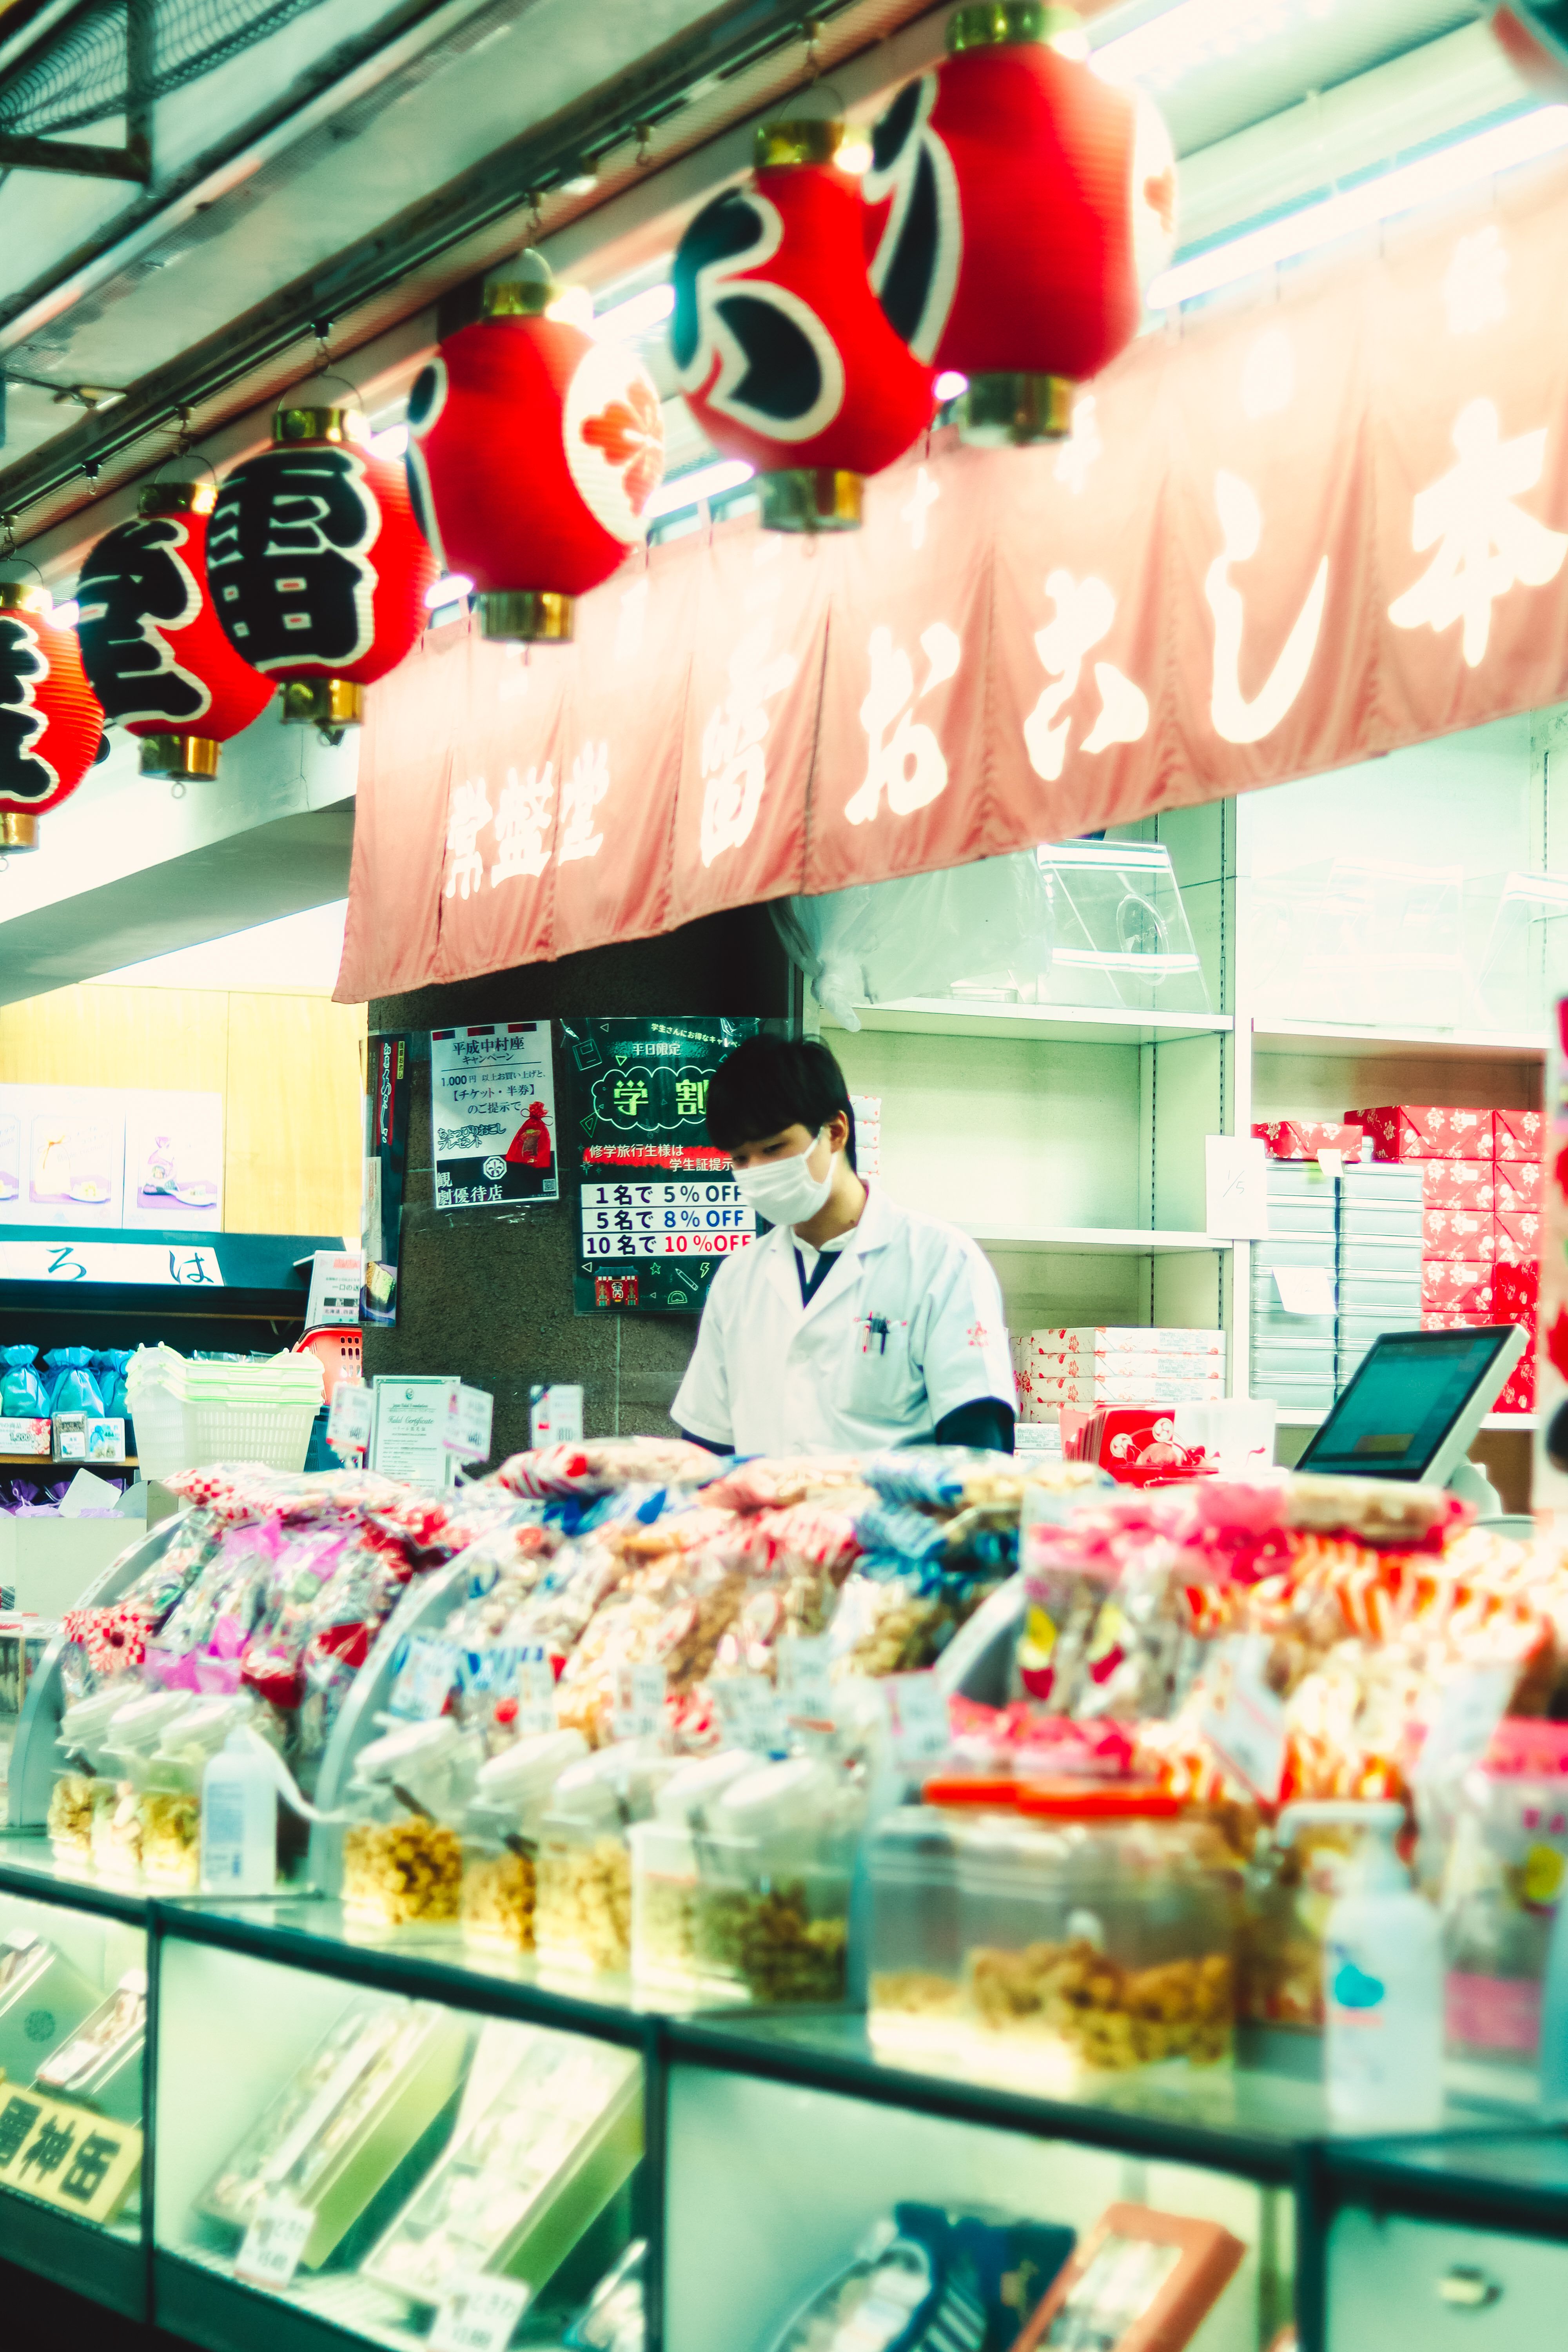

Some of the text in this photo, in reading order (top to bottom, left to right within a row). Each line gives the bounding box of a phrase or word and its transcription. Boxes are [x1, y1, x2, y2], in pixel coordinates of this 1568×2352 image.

[651, 1023, 740, 1047] 学生さんにお得なキャペ
[453, 1036, 525, 1056] 平成中村座
[632, 1043, 682, 1056] 平日限定
[462, 1053, 515, 1065] キャンペーン
[454, 1084, 535, 1102] 【チケット・半券】
[468, 1101, 522, 1114] のご提示で
[589, 1144, 684, 1159] 修学旅行生様は
[669, 1158, 734, 1172] 学生証提示
[706, 1210, 744, 1227] OFF
[406, 1415, 434, 1426] Certificate
